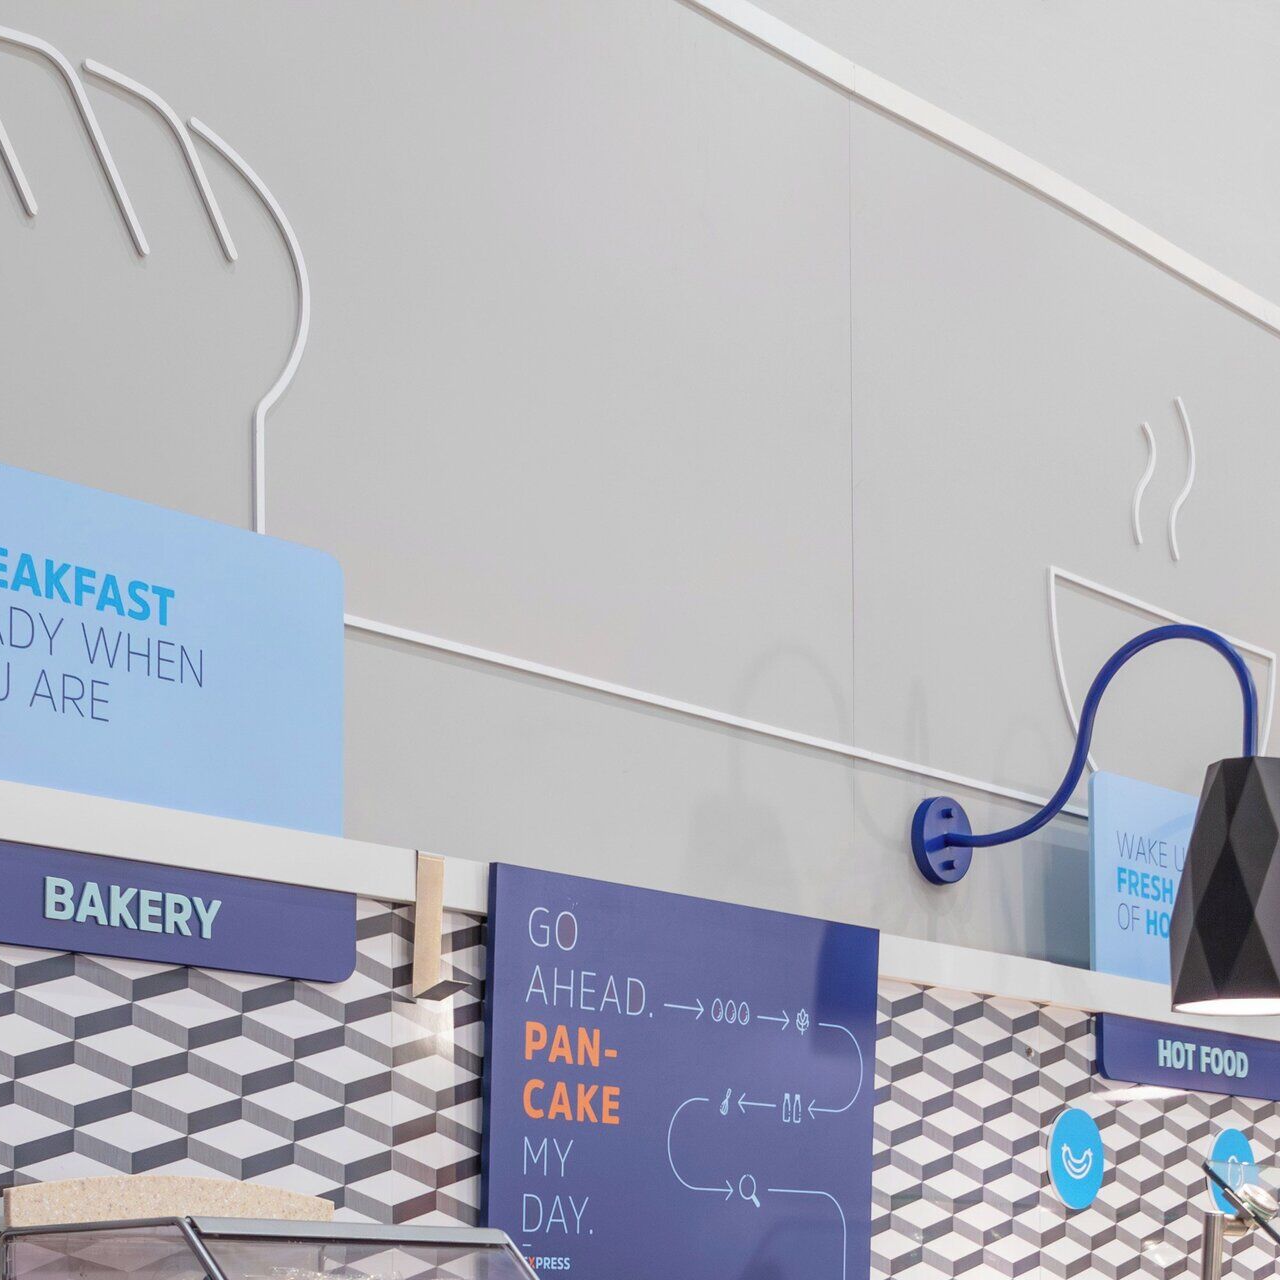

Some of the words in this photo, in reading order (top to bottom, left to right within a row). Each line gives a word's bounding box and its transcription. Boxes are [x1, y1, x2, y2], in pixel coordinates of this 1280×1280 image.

[81, 621, 205, 688] WHEN
[29, 669, 110, 722] ARE
[1116, 830, 1167, 869] WAKE
[1174, 845, 1185, 873] U
[1117, 866, 1174, 905] FRESH
[44, 876, 222, 940] BAKERY
[528, 907, 578, 951] GO
[1118, 902, 1140, 932] OF
[1146, 909, 1170, 939] HO
[525, 965, 654, 1018] AHEAD.
[524, 1021, 618, 1067] PAN-
[1157, 1038, 1194, 1070] HOT
[1200, 1045, 1249, 1079] FOOD
[523, 1079, 621, 1125] CAKE
[523, 1136, 574, 1177] MY
[522, 1194, 593, 1235] DAY.
